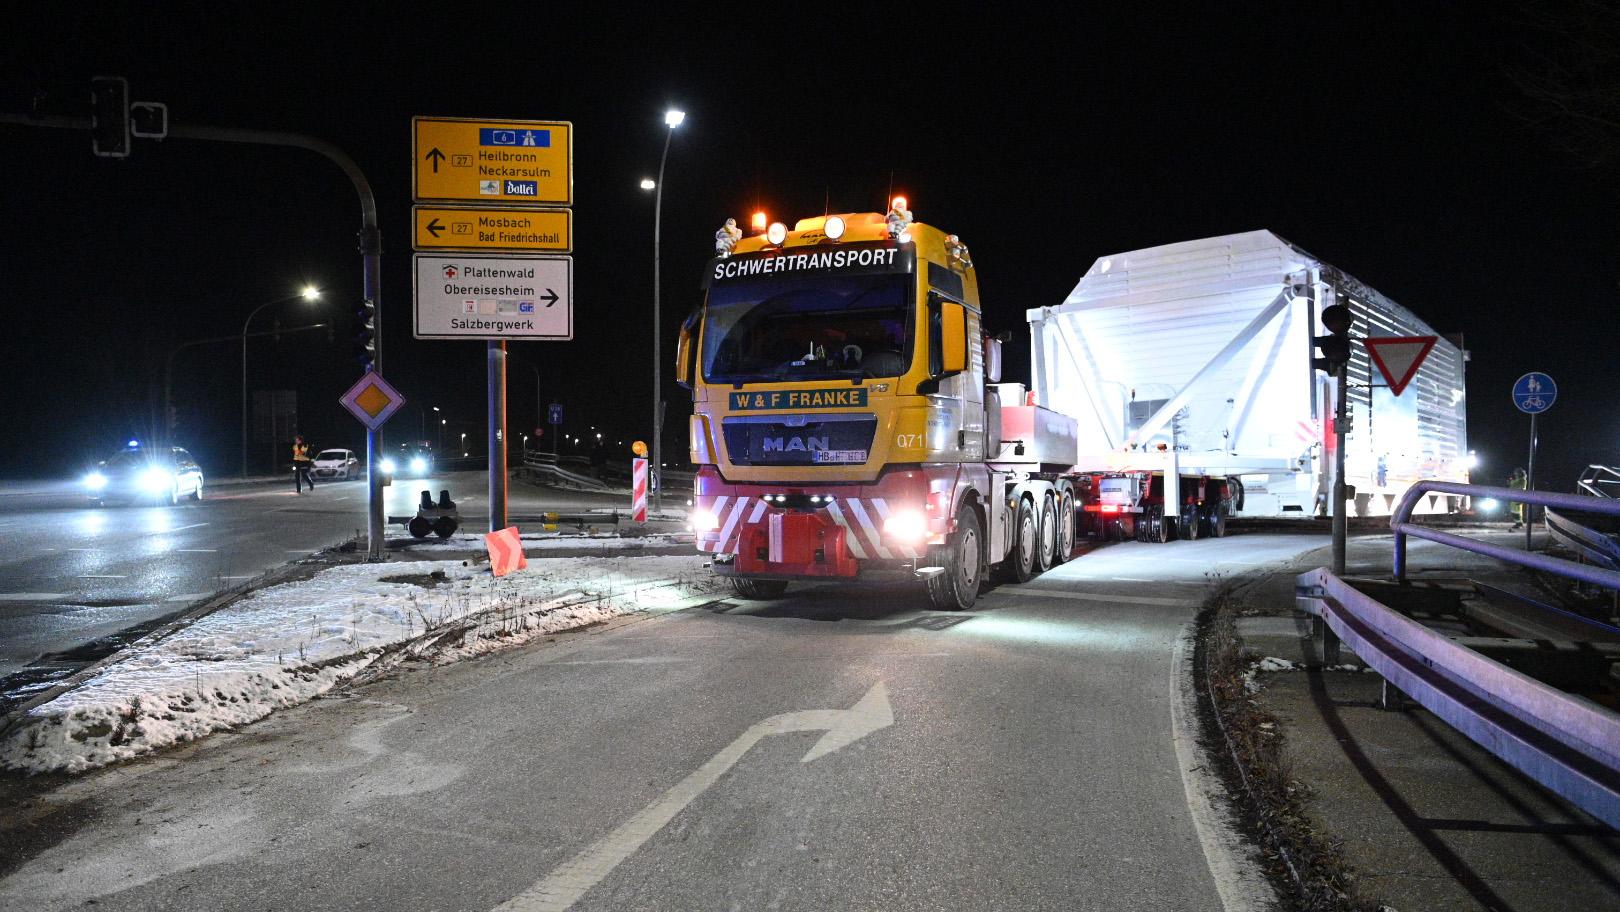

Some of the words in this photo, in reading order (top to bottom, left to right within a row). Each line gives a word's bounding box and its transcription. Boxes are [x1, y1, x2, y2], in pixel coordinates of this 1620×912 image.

[501, 133, 507, 142] 6
[457, 157, 468, 165] 27
[479, 151, 537, 163] Heilbronn
[479, 166, 551, 178] Neckarsulm
[457, 225, 468, 233] 27
[479, 217, 531, 229] Mosbach
[479, 232, 495, 242] Bad
[499, 232, 560, 244] Friedrichshall
[714, 249, 898, 280] SCHWERTRANSPORT
[464, 267, 535, 279] Plattenwald
[444, 284, 535, 296] Obereisesheim
[451, 318, 534, 332] Salzbergwerk
[736, 394, 750, 408] W
[754, 394, 765, 407] &
[771, 393, 781, 407] F
[789, 390, 860, 406] FRANKE
[763, 437, 829, 452] MAN
